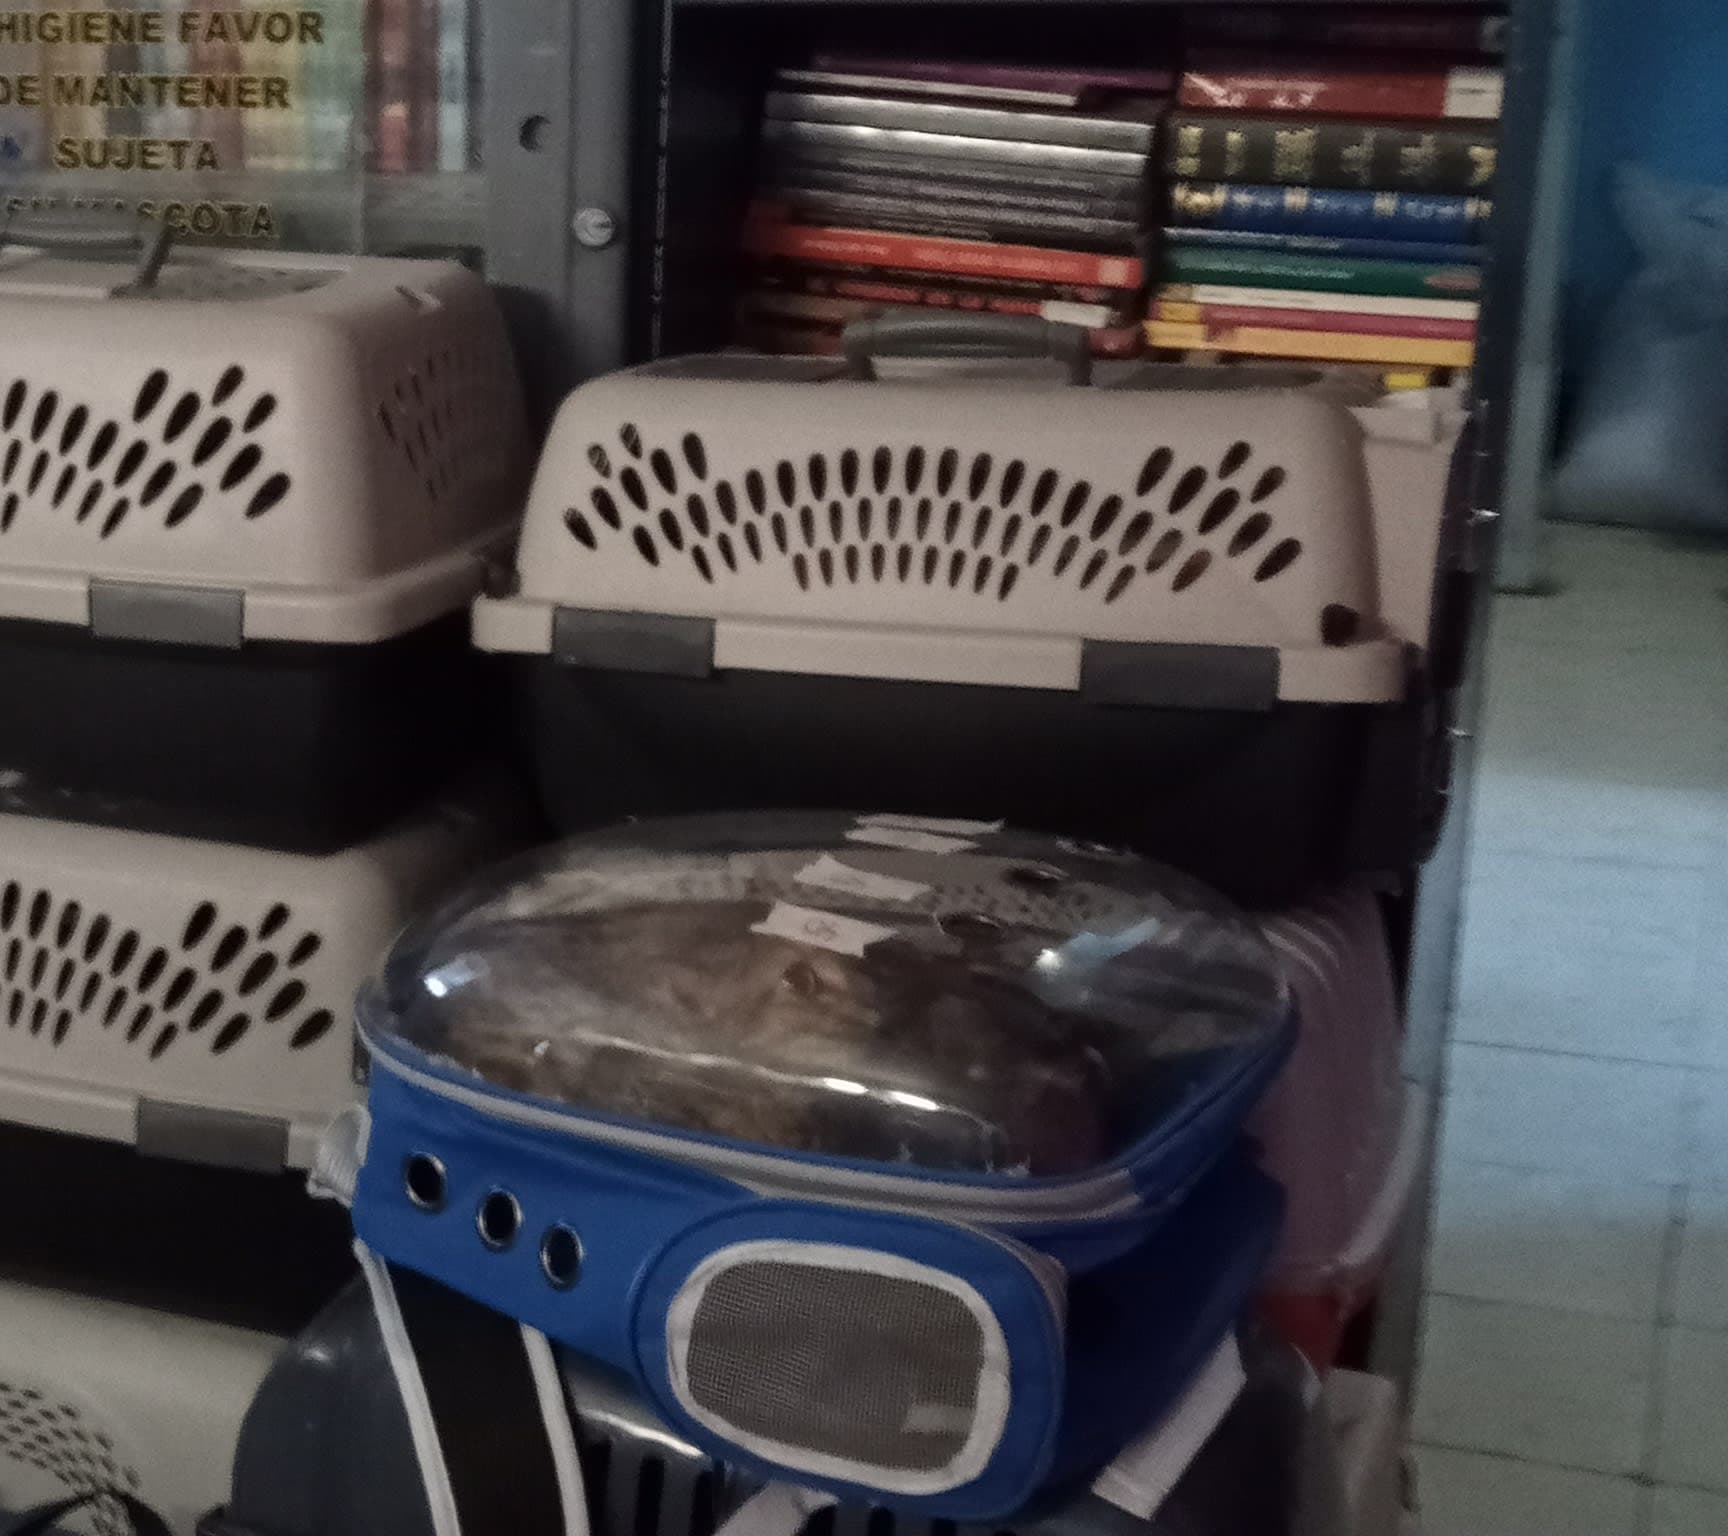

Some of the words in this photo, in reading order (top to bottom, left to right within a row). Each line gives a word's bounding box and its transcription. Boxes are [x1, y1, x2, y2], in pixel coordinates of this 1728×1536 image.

[178, 10, 325, 46] FAVOR
[52, 73, 292, 111] MANTENER
[52, 136, 221, 172] SUJETA
